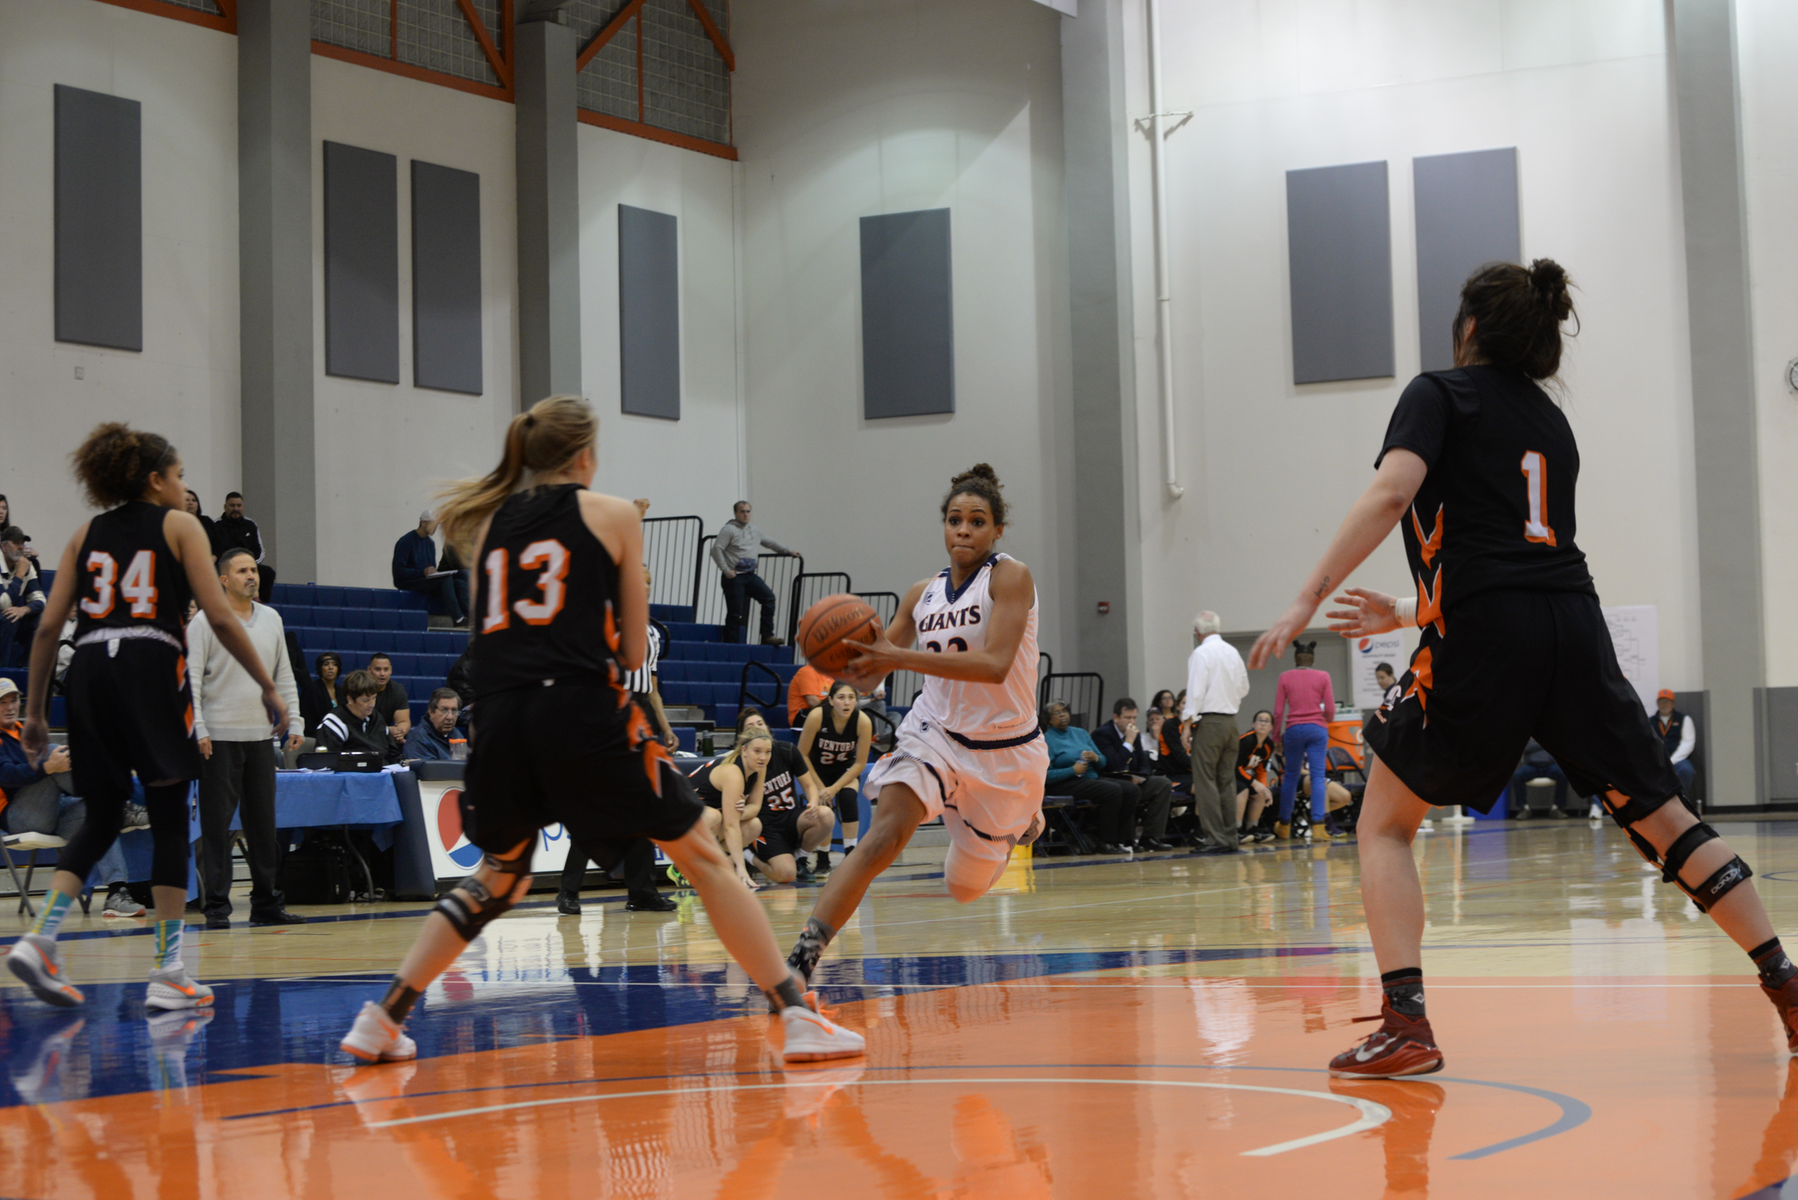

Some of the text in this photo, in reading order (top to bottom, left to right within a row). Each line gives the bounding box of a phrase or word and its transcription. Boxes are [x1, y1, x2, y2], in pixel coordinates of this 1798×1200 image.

[1521, 450, 1557, 547] 1
[80, 550, 159, 619] 34
[481, 538, 571, 634] 13
[918, 604, 981, 633] GIANTS
[1374, 640, 1400, 650] pepsi
[820, 751, 849, 765] 24
[767, 787, 796, 811] 25
